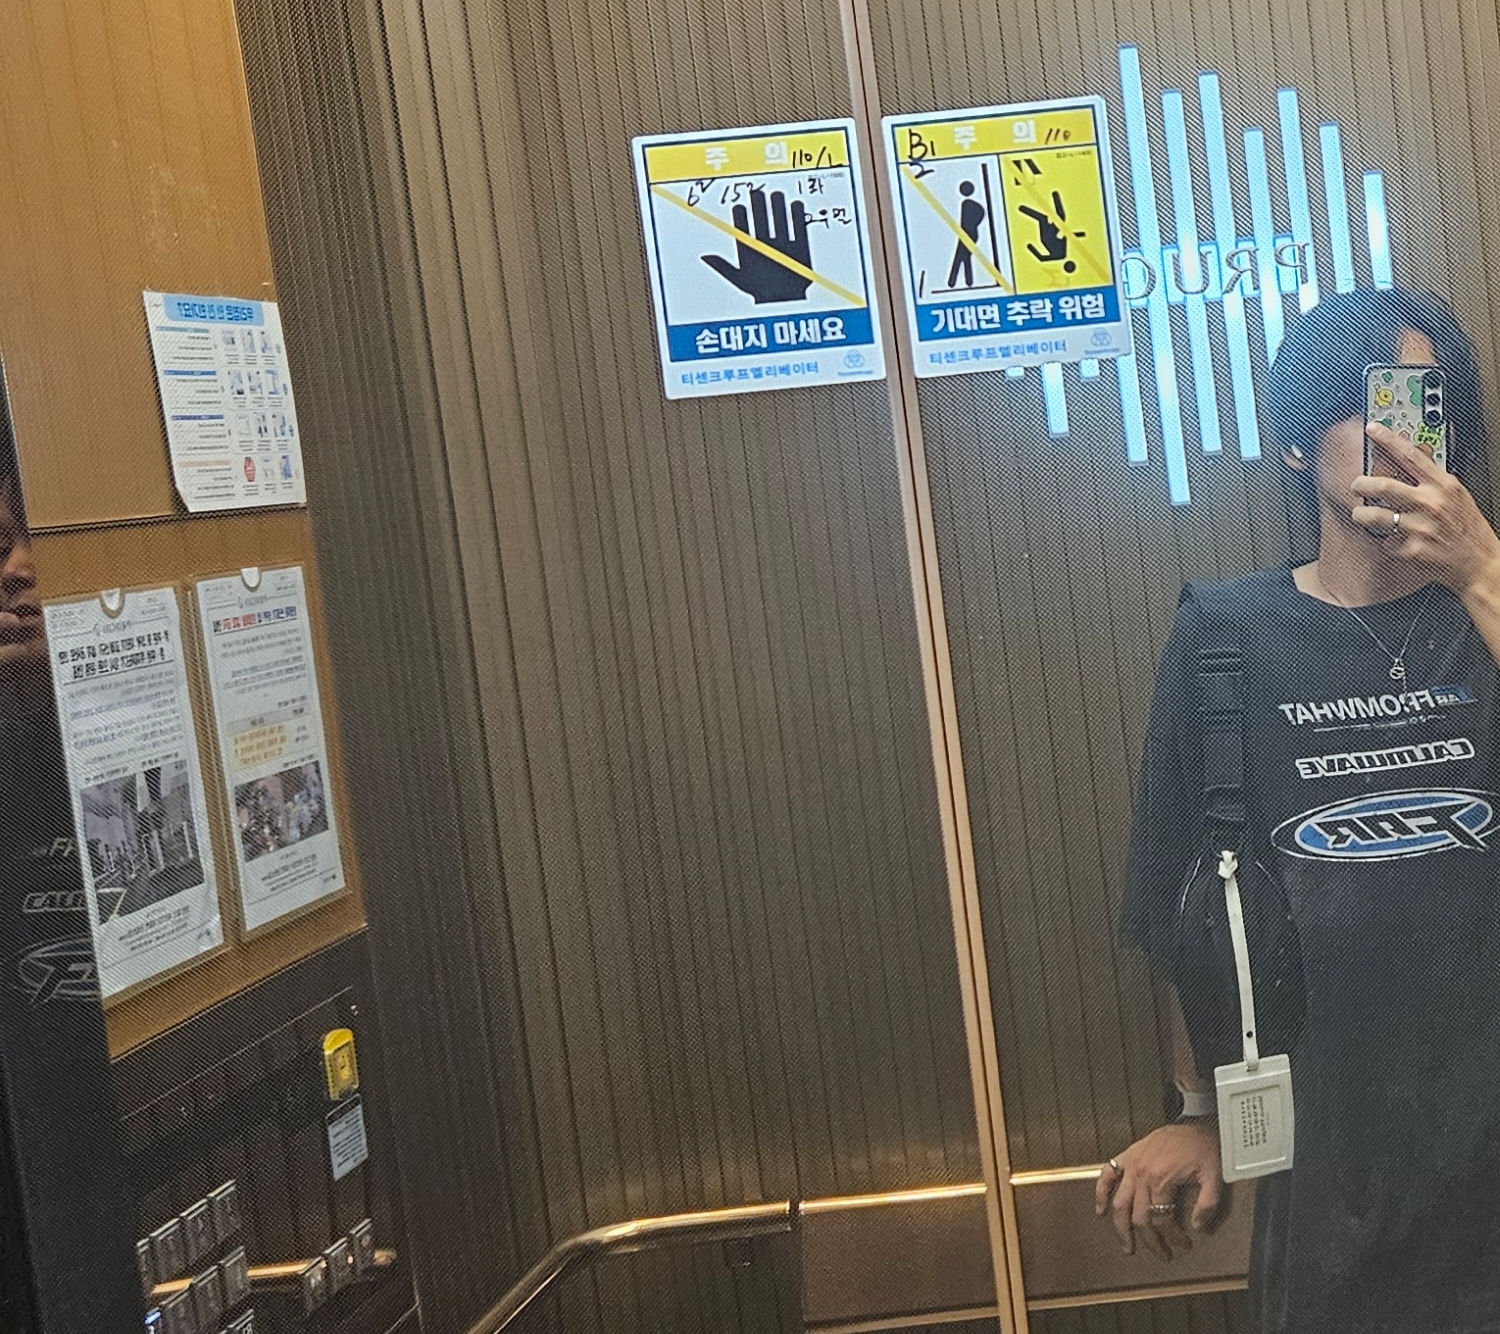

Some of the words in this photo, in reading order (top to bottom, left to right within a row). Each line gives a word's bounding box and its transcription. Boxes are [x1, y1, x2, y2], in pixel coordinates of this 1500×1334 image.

[930, 304, 1000, 332] 기대면
[1007, 298, 1053, 325] 추락
[1059, 293, 1105, 320] 위험
[695, 324, 767, 353] 손대지
[774, 317, 846, 345] 마세요
[929, 340, 1067, 364] 티센크루프엘리베이터
[681, 361, 819, 385] 티센크루프엘리베이터
